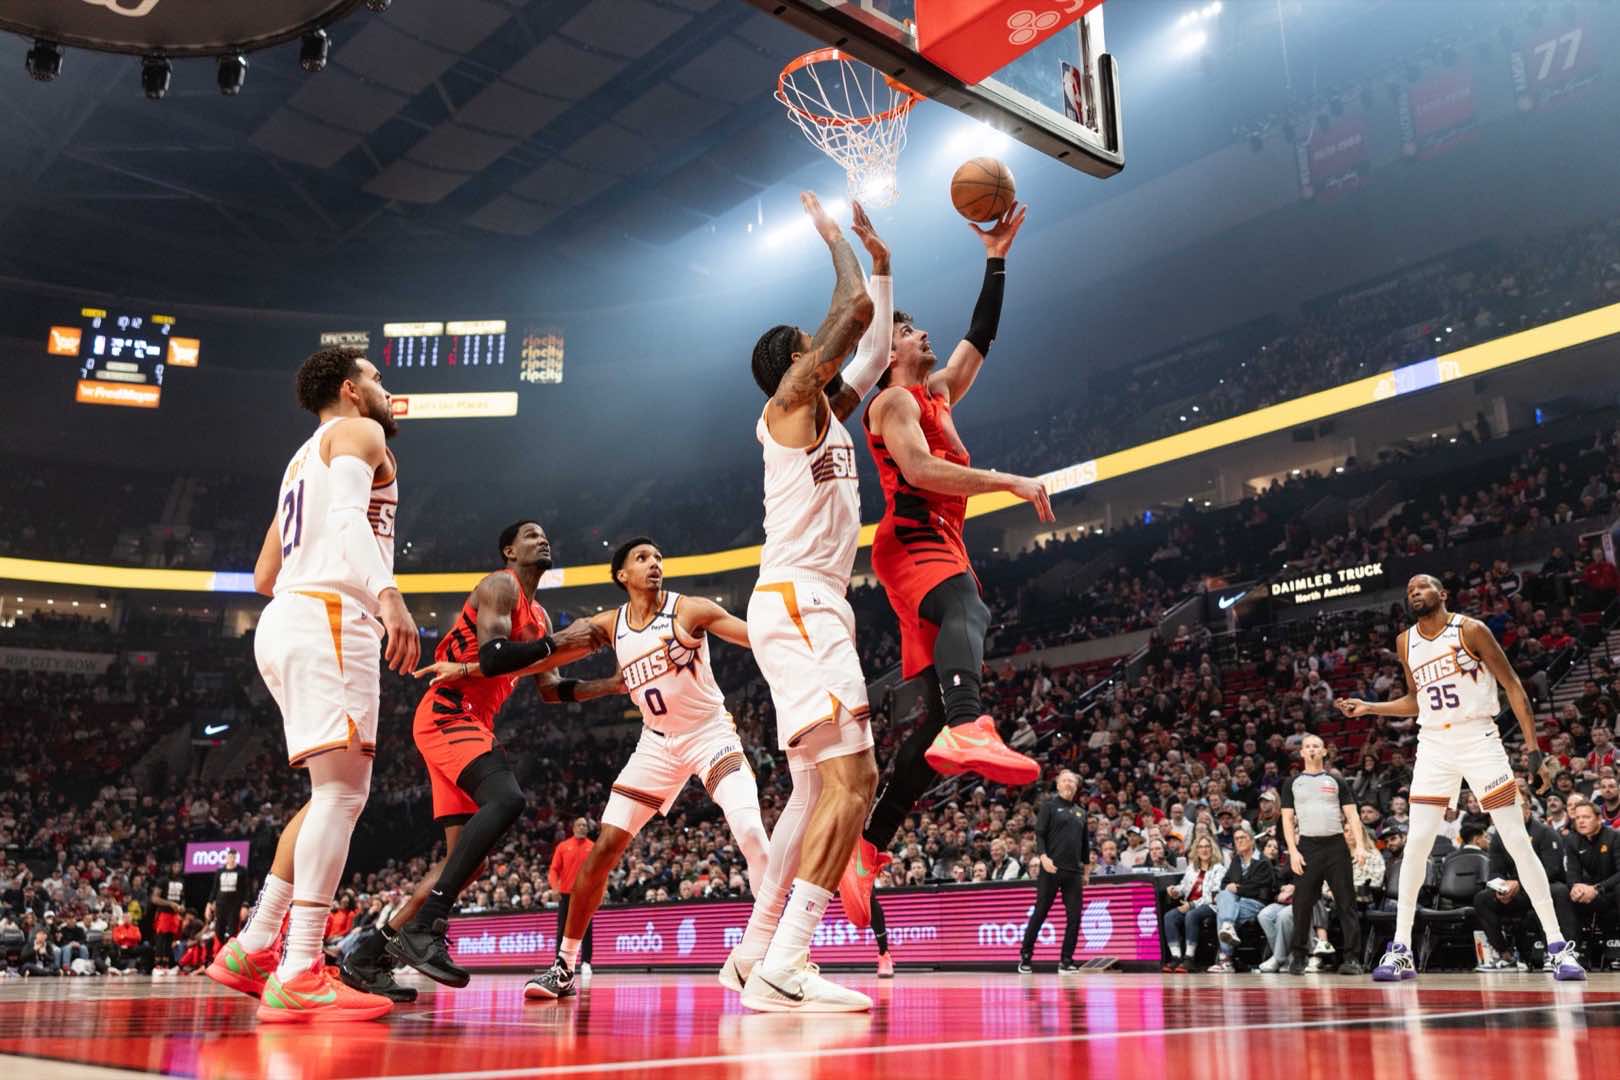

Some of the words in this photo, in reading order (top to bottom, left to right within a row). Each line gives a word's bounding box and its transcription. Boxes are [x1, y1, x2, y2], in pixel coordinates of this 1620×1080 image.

[1533, 28, 1583, 80] 77
[520, 368, 562, 383] ripcity
[282, 479, 305, 559] 21
[1271, 573, 1332, 596] DAIMLER
[1337, 562, 1383, 582] TRUCK
[1295, 590, 1321, 604] North
[1323, 583, 1361, 599] America
[645, 688, 667, 716] 0
[1426, 684, 1460, 710] 35
[616, 921, 663, 952] moda
